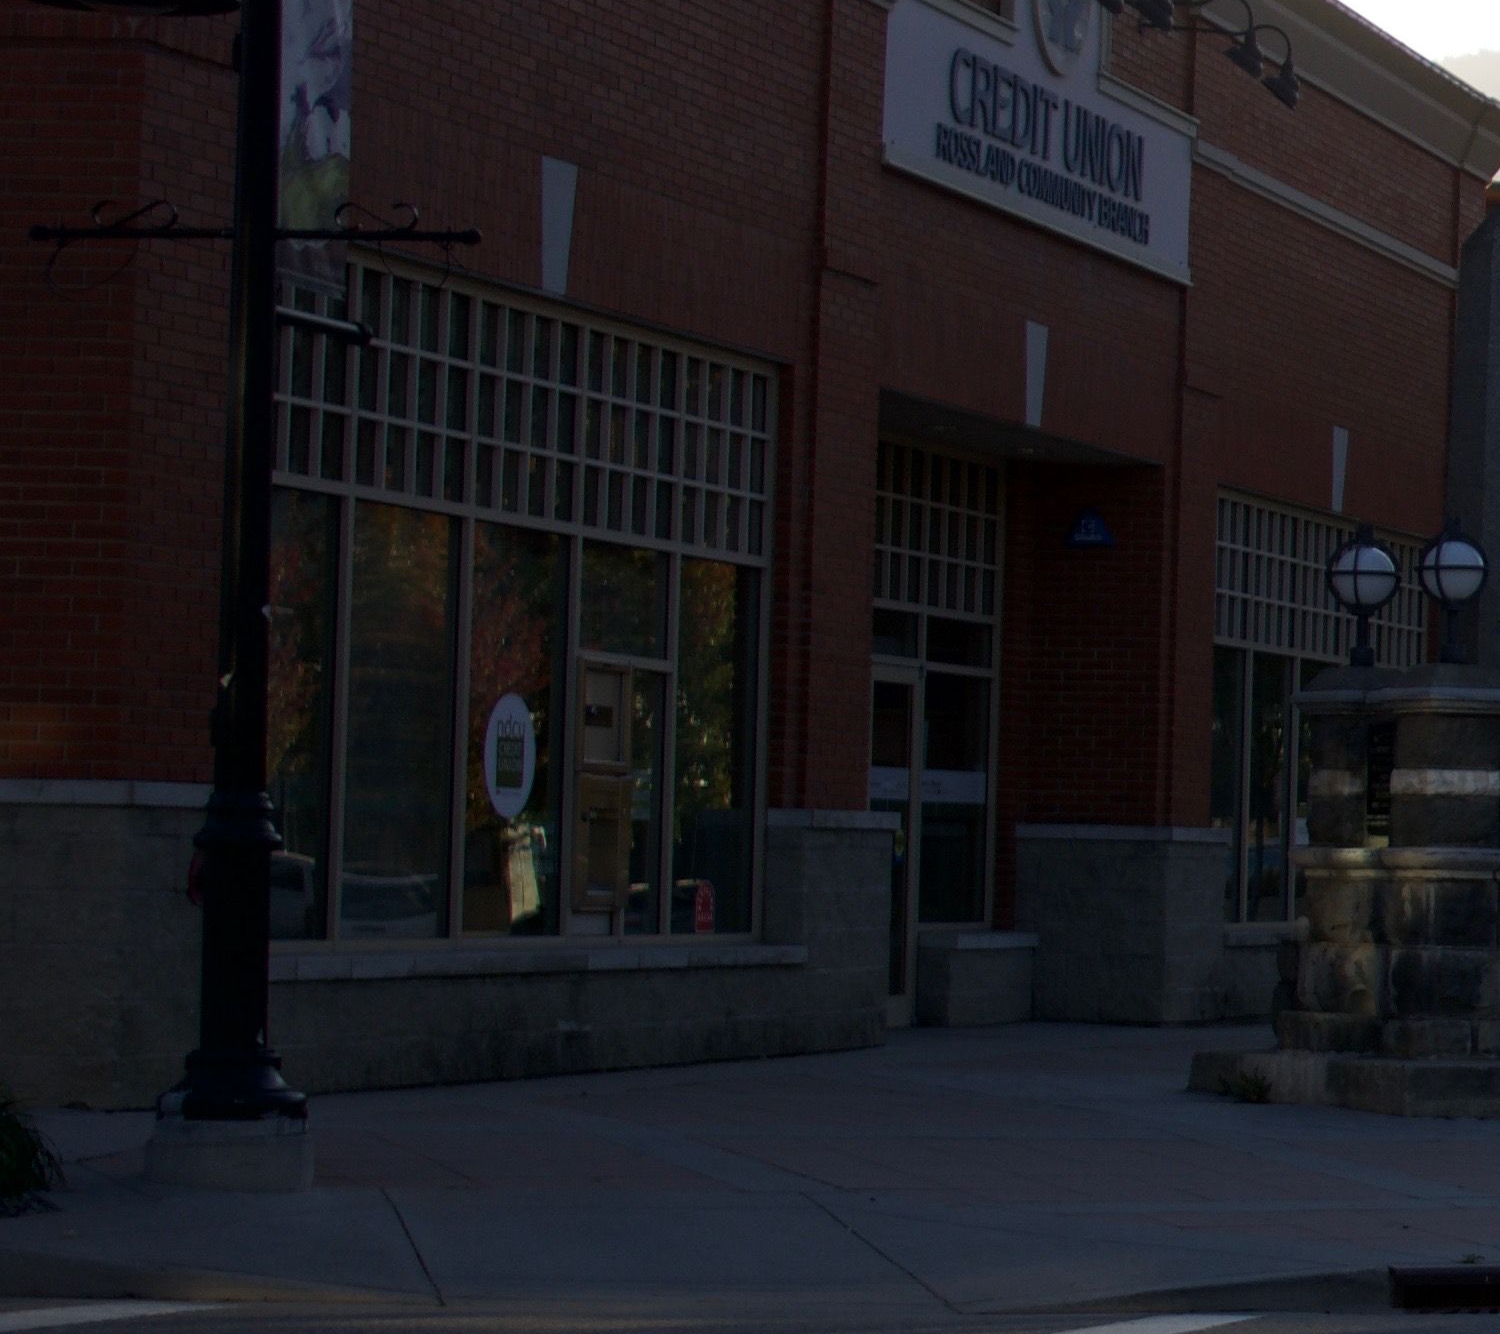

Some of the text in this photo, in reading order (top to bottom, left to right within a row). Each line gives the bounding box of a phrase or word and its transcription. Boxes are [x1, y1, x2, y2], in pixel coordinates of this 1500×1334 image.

[935, 122, 1150, 245] ROSSLAND COMMUNITY BRANCH
[948, 47, 1145, 202] CREDIT UNION
